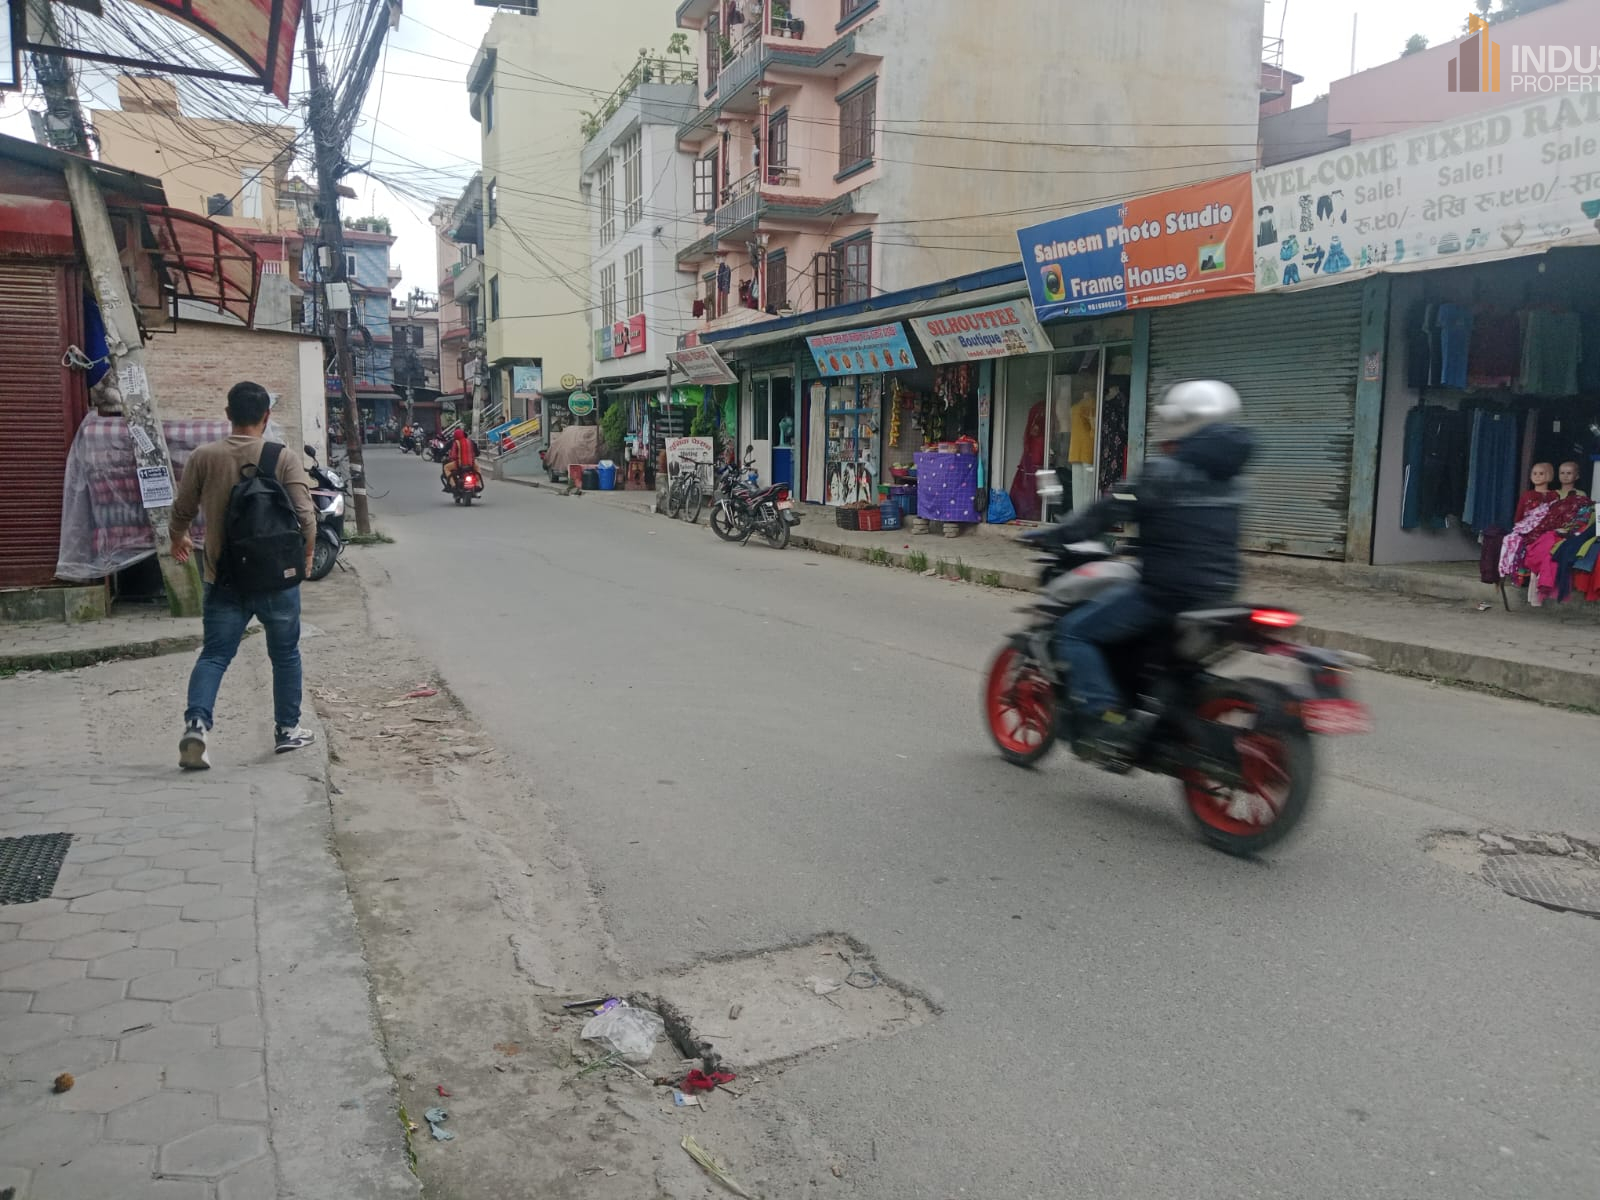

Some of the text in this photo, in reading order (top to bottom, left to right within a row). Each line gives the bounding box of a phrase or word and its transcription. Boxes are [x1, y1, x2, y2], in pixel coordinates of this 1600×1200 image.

[1406, 115, 1511, 165] FIXED
[1354, 177, 1402, 205] Sale!
[1438, 154, 1503, 187] Sale!!
[1106, 220, 1161, 248] Photo
[1165, 202, 1233, 235] Studio
[1120, 251, 1129, 263] &
[1070, 263, 1187, 297] Frame House
[927, 307, 1020, 336] SILHOUTTEE
[959, 332, 1001, 348] Boutique
